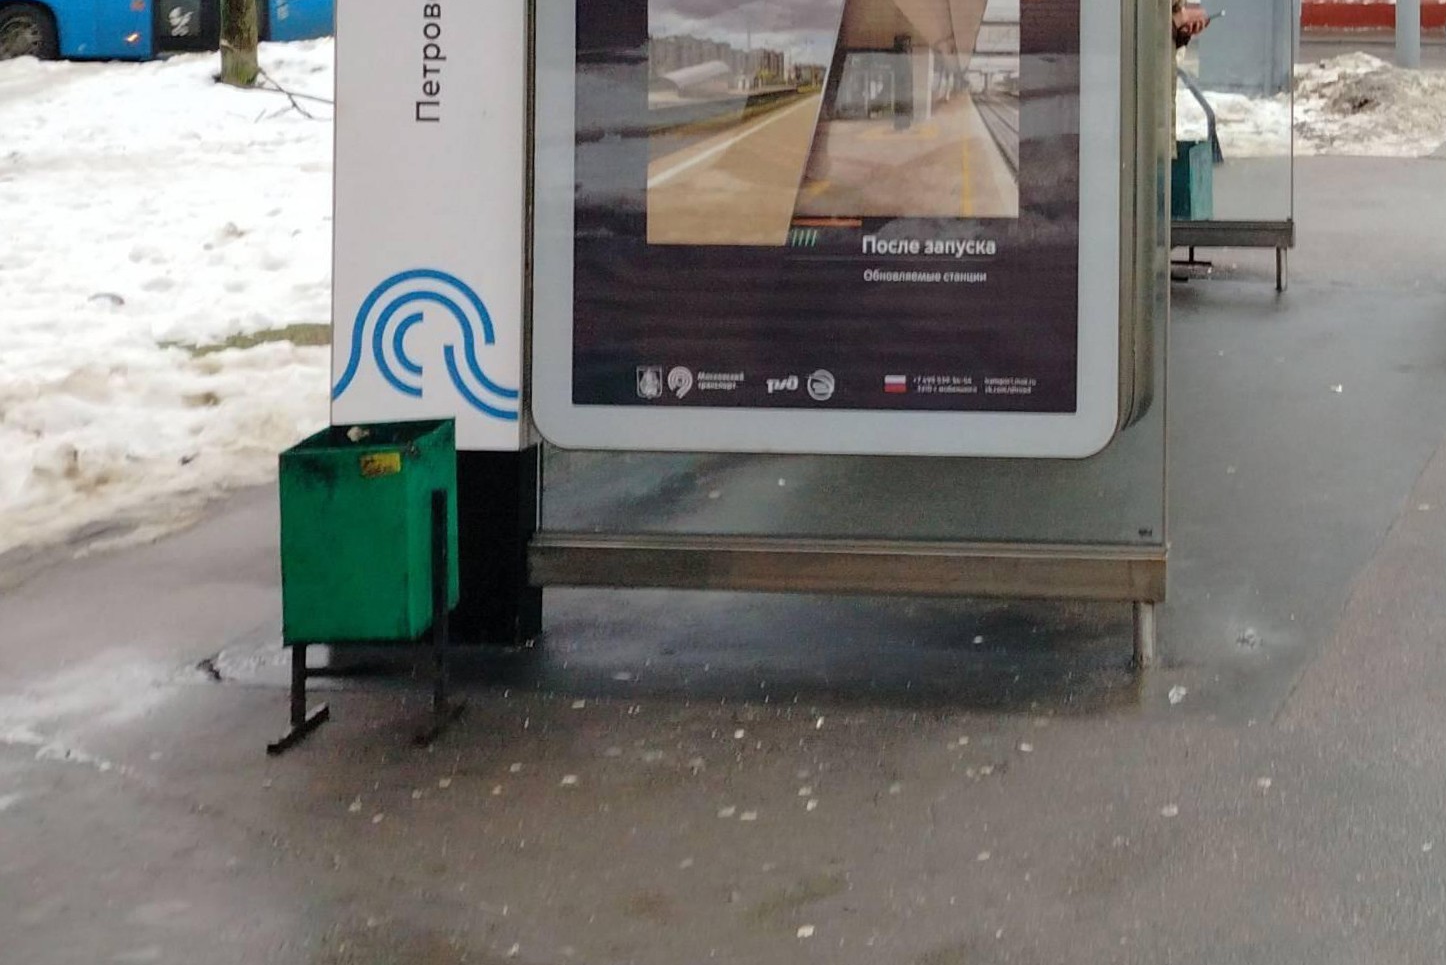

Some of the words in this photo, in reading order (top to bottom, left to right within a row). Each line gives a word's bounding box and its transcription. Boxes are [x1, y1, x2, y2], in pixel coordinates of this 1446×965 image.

[862, 235, 920, 255] После
[924, 239, 996, 259] запуска
[863, 269, 941, 283] Обновляемые
[943, 272, 988, 284] станции
